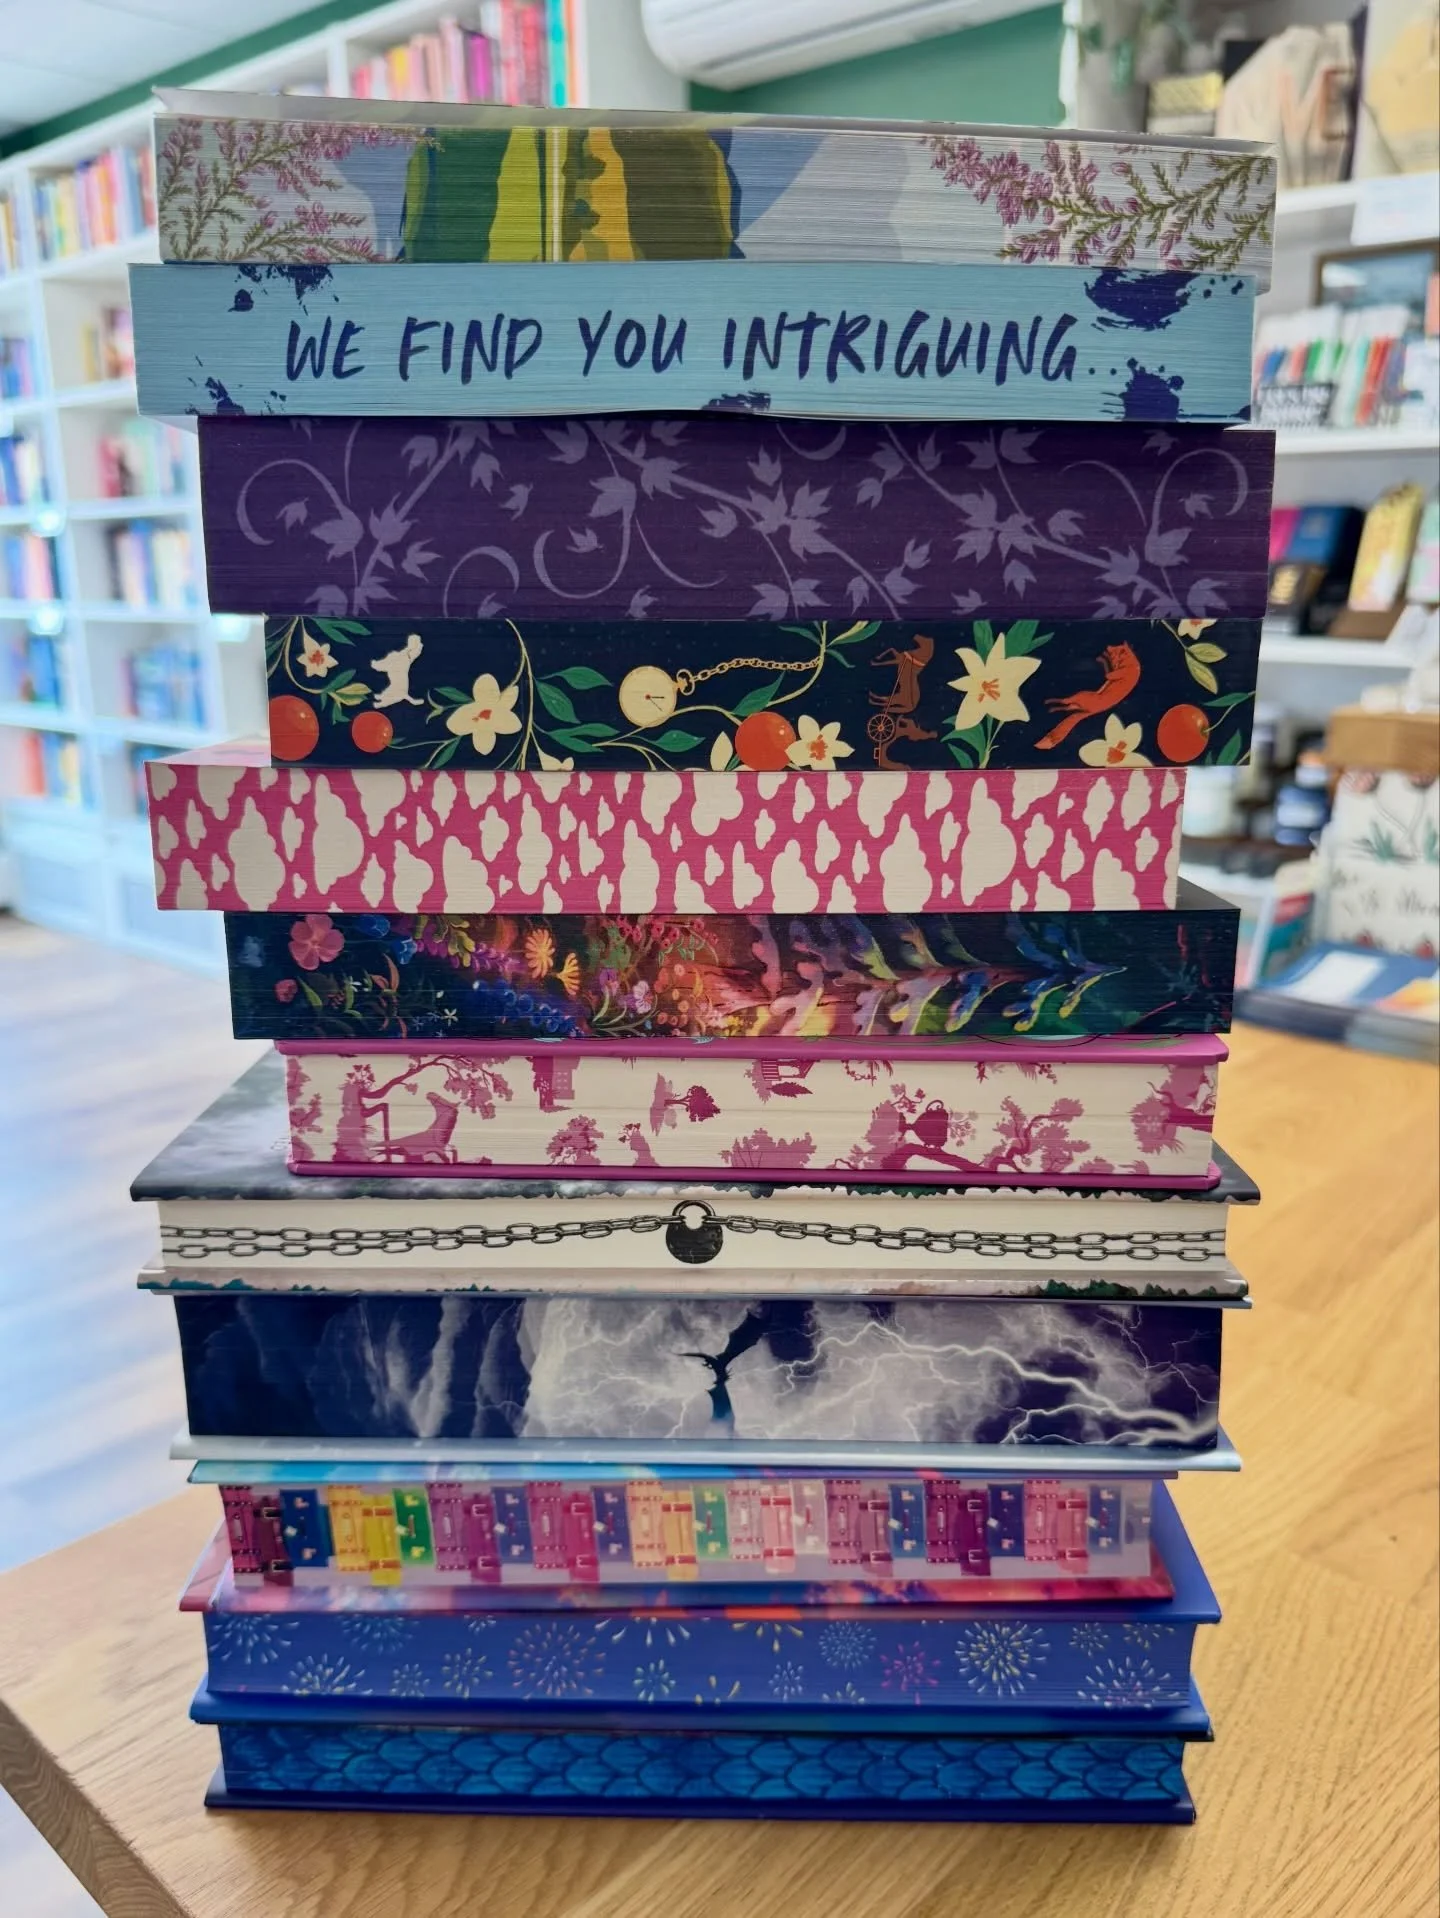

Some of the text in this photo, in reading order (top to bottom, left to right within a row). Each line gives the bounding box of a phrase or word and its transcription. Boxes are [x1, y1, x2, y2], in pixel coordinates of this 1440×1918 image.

[286, 315, 365, 381] WE
[399, 313, 543, 385] FIND
[578, 309, 687, 374] YOU
